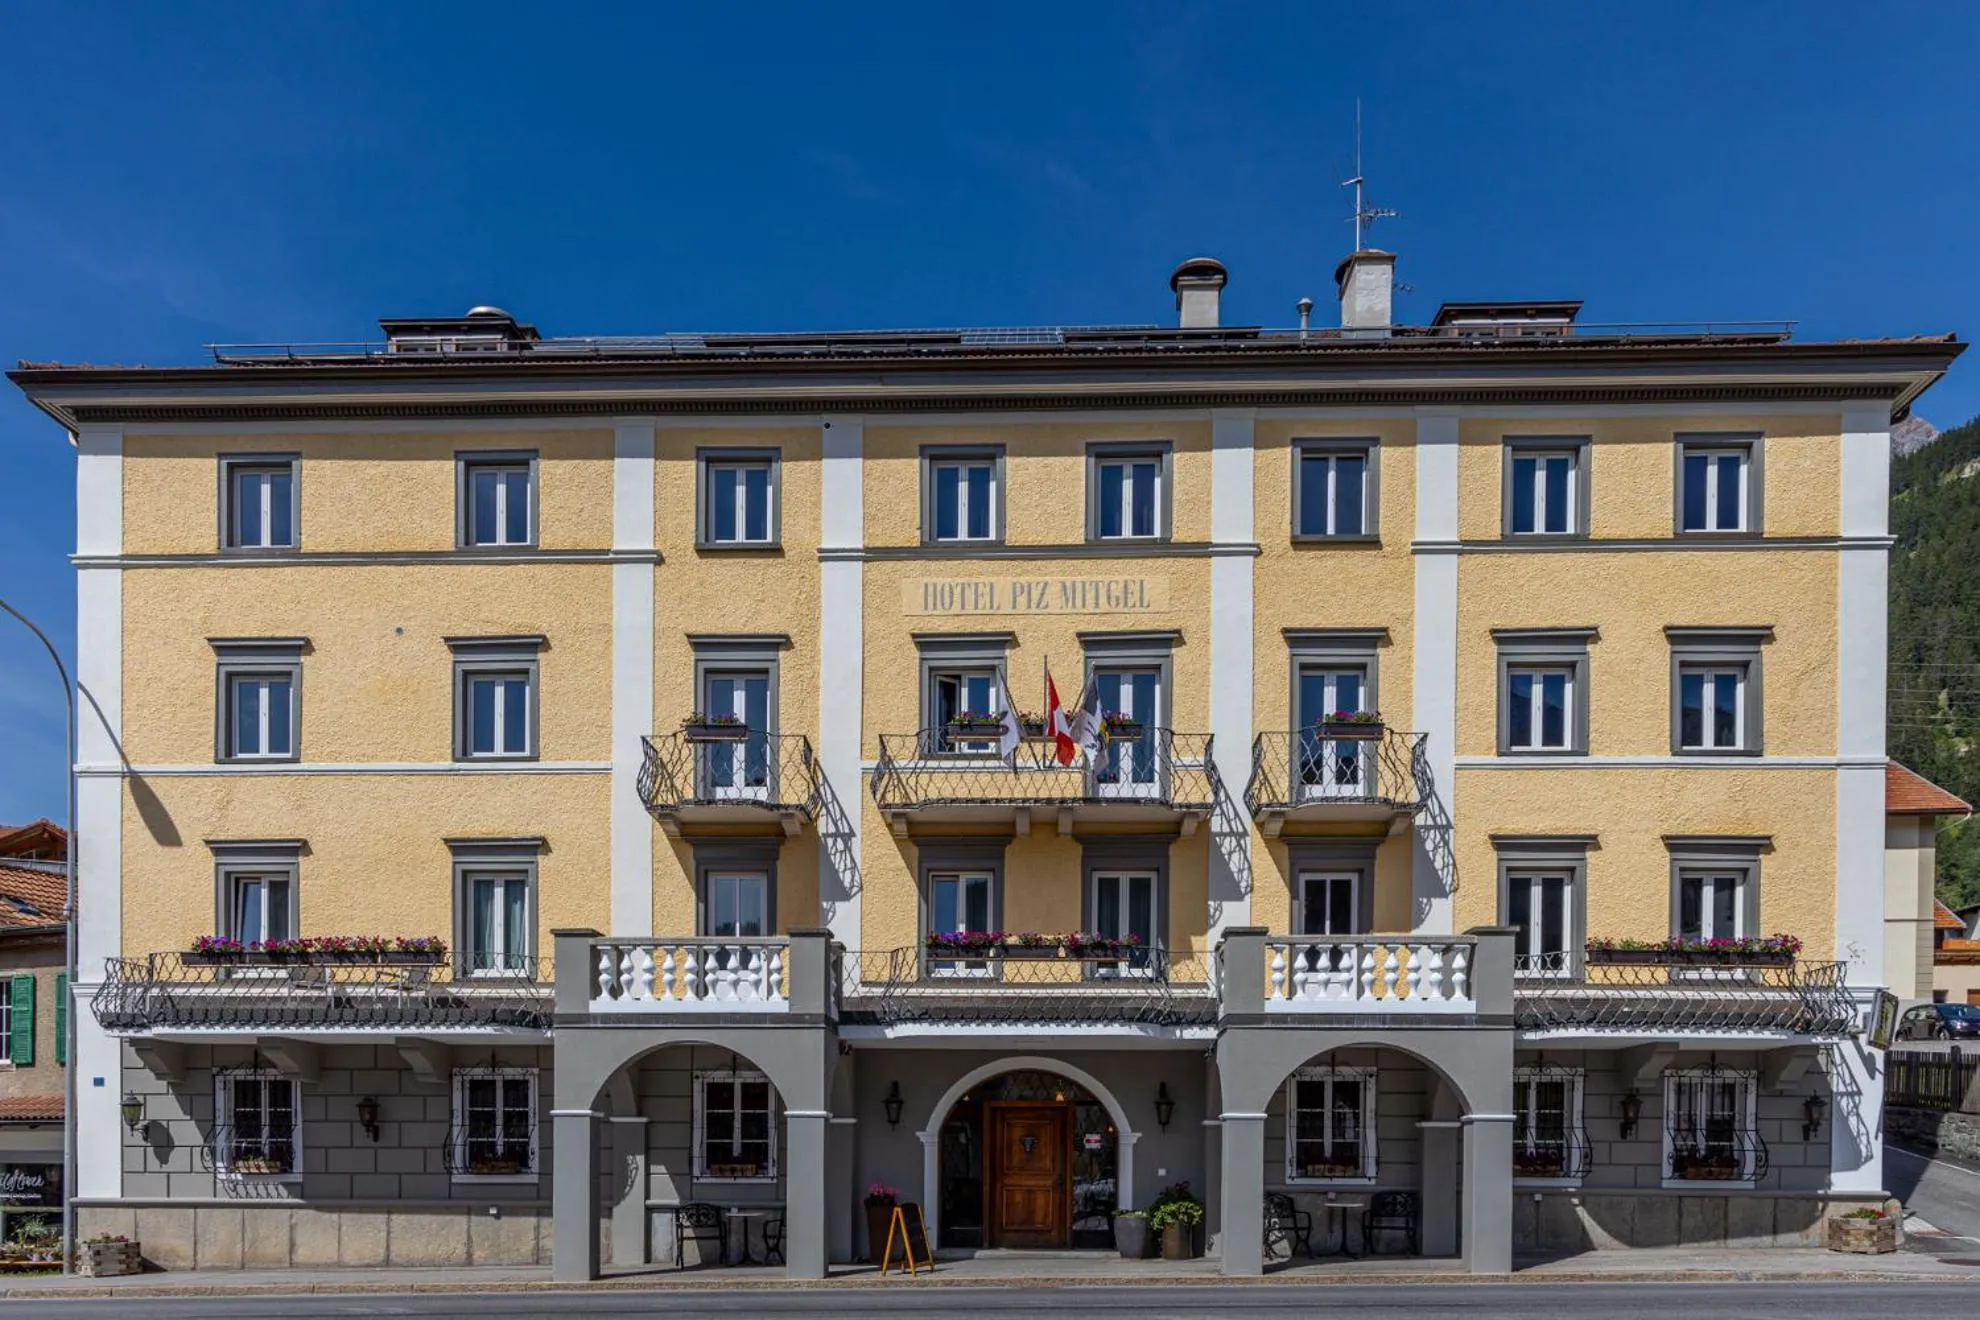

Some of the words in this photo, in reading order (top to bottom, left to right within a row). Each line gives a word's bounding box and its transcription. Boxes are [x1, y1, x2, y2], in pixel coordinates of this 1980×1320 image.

[922, 581, 1001, 611] HOTEL
[1011, 580, 1049, 610] PIZ
[1059, 578, 1150, 609] MITGEL
